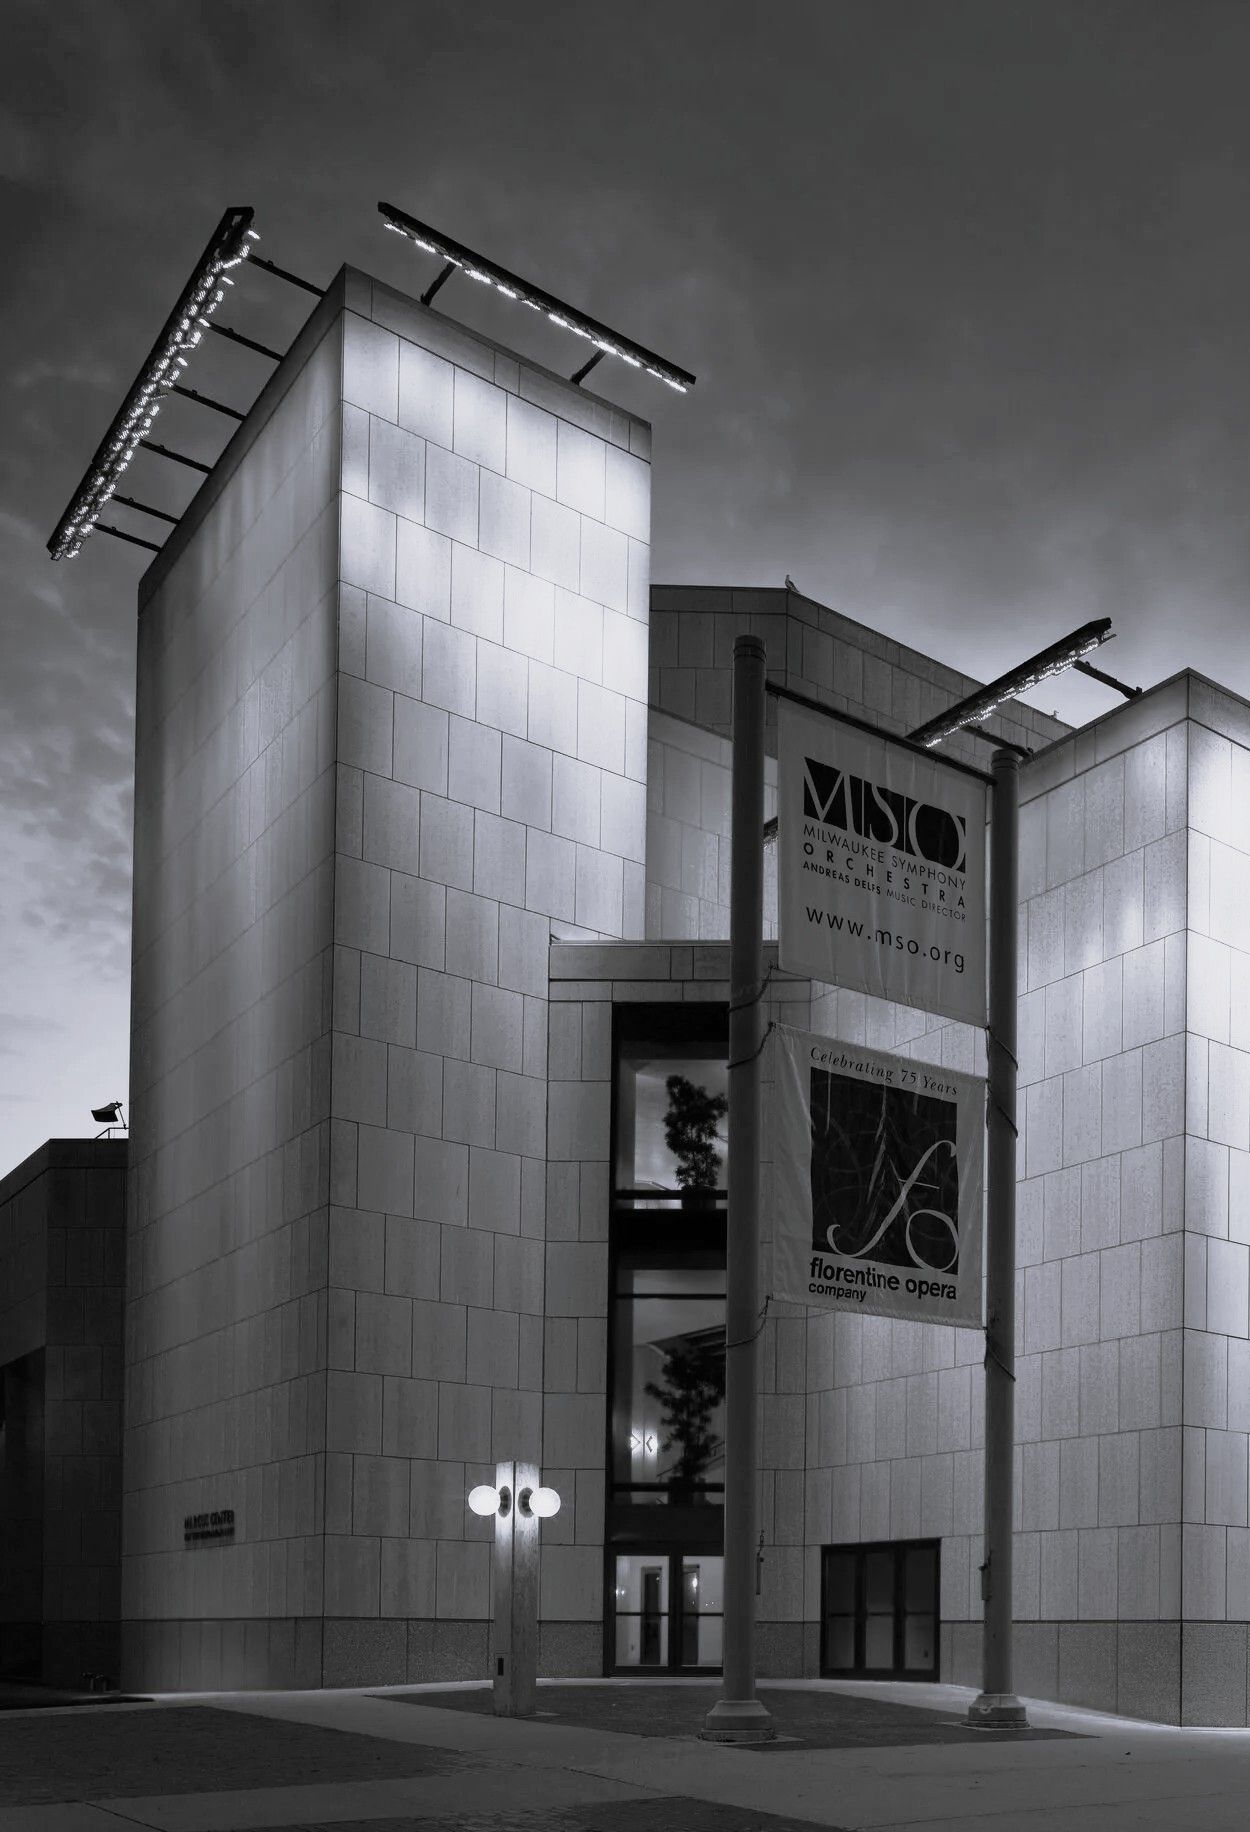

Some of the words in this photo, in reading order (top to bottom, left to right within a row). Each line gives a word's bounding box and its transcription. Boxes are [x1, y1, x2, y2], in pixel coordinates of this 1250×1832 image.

[803, 823, 885, 864] MILWAUKEE
[891, 855, 966, 891] SYMPHONY
[803, 842, 965, 908] ORCHESTRA
[803, 861, 850, 884] ANDREAS
[854, 878, 881, 895] DELFS
[886, 889, 917, 907] MUSIC
[921, 900, 966, 922] DIRECTOR
[806, 906, 965, 973] www.mso.org
[810, 1046, 894, 1083] Celebrating
[901, 1069, 917, 1084] 75
[923, 1075, 958, 1096] Years
[808, 1283, 867, 1303] company
[809, 1256, 900, 1291] florentine
[905, 1278, 957, 1300] opera
